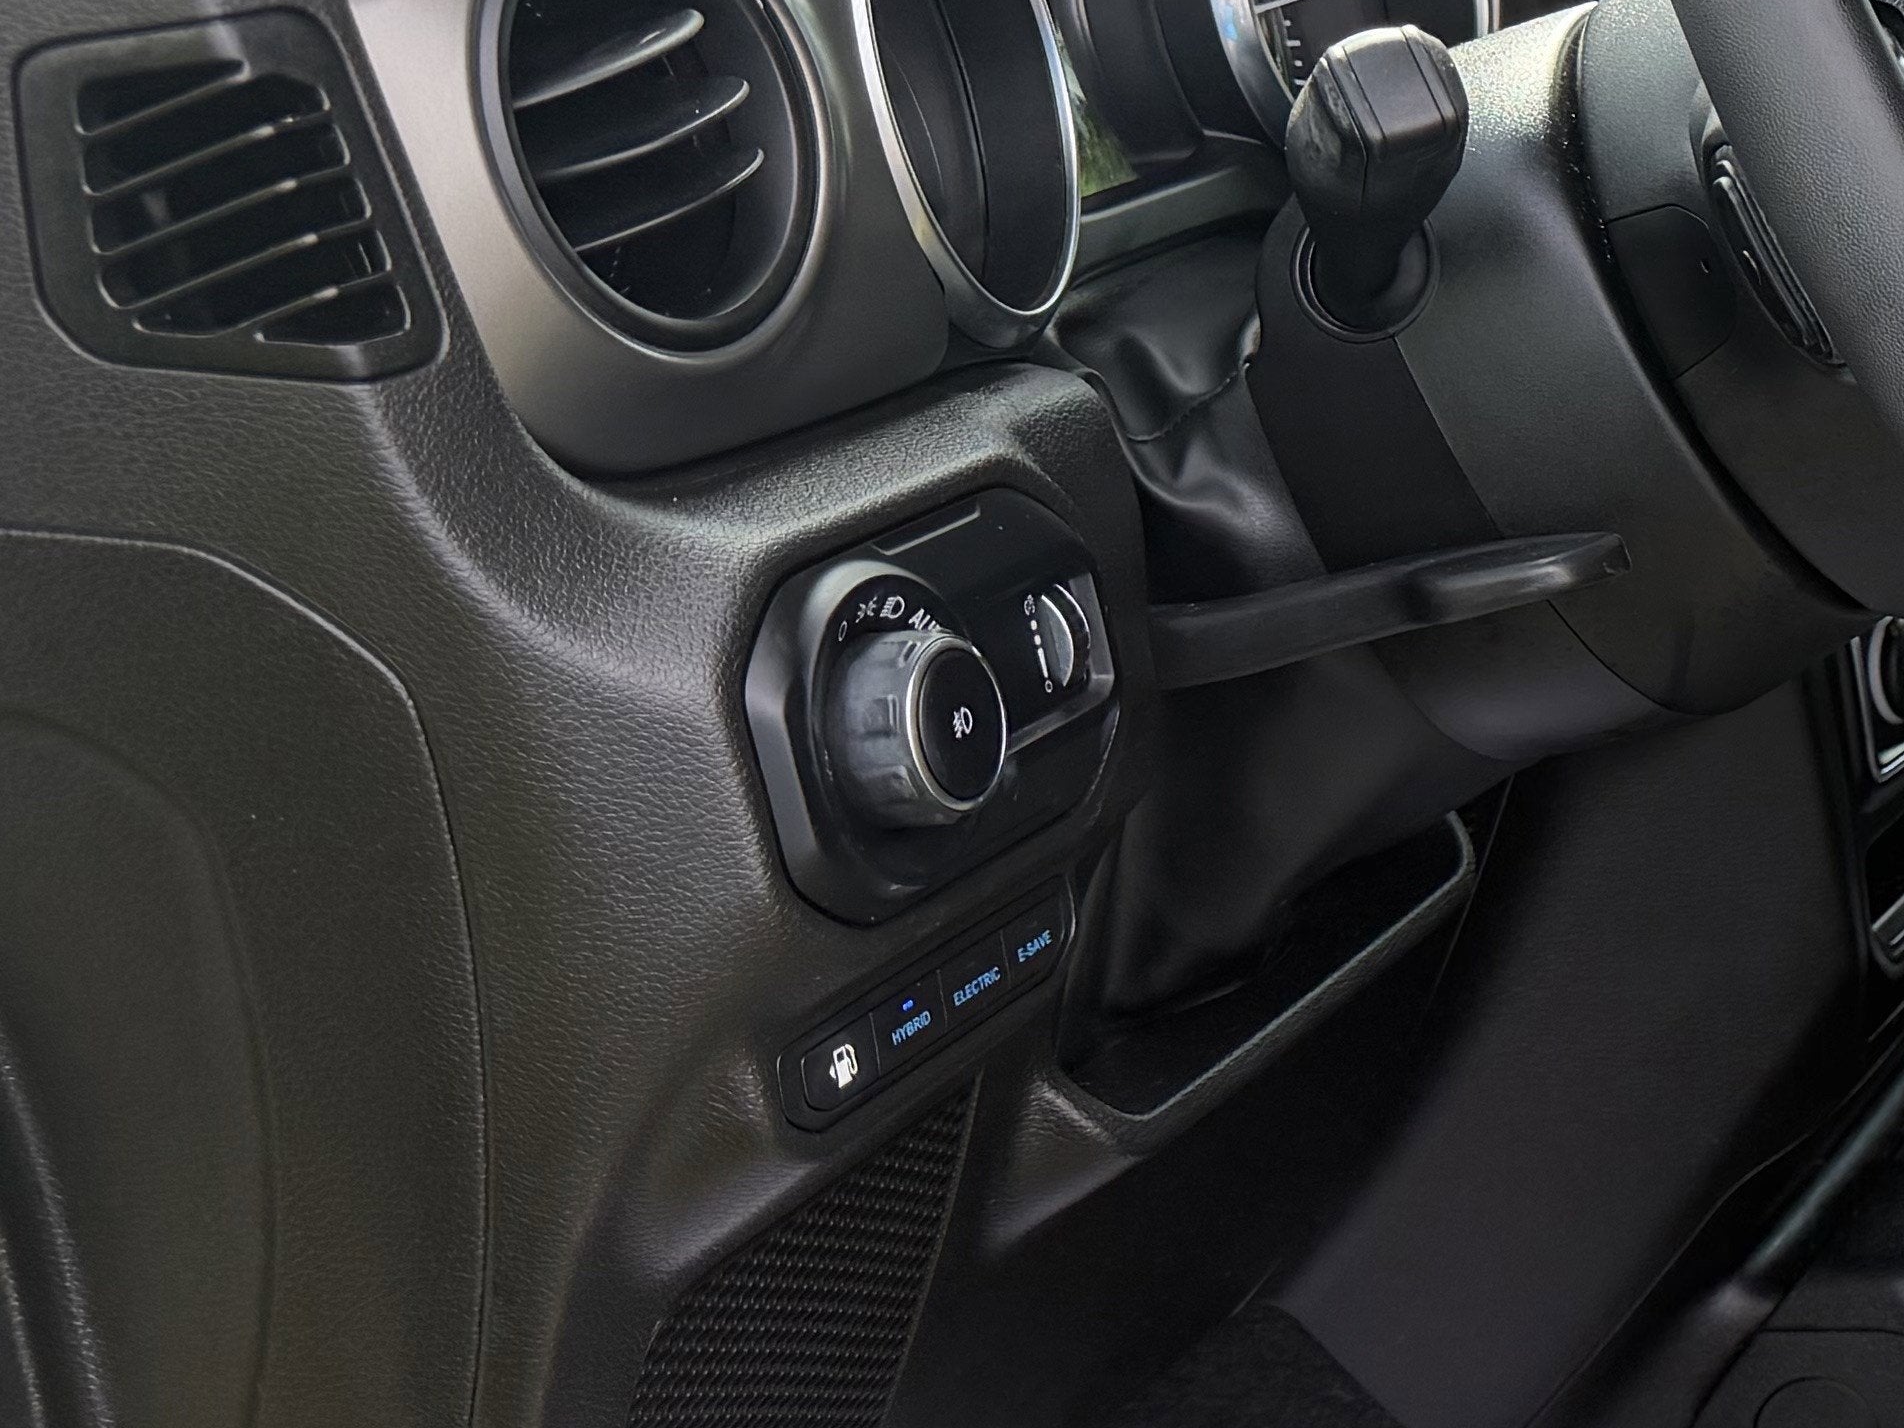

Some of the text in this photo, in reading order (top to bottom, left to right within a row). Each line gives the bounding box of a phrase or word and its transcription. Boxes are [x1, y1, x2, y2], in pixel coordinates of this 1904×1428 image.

[1016, 930, 1053, 963] E-SAVE
[953, 967, 1002, 1007] ELECTRIC
[890, 1010, 932, 1046] HYBRID
